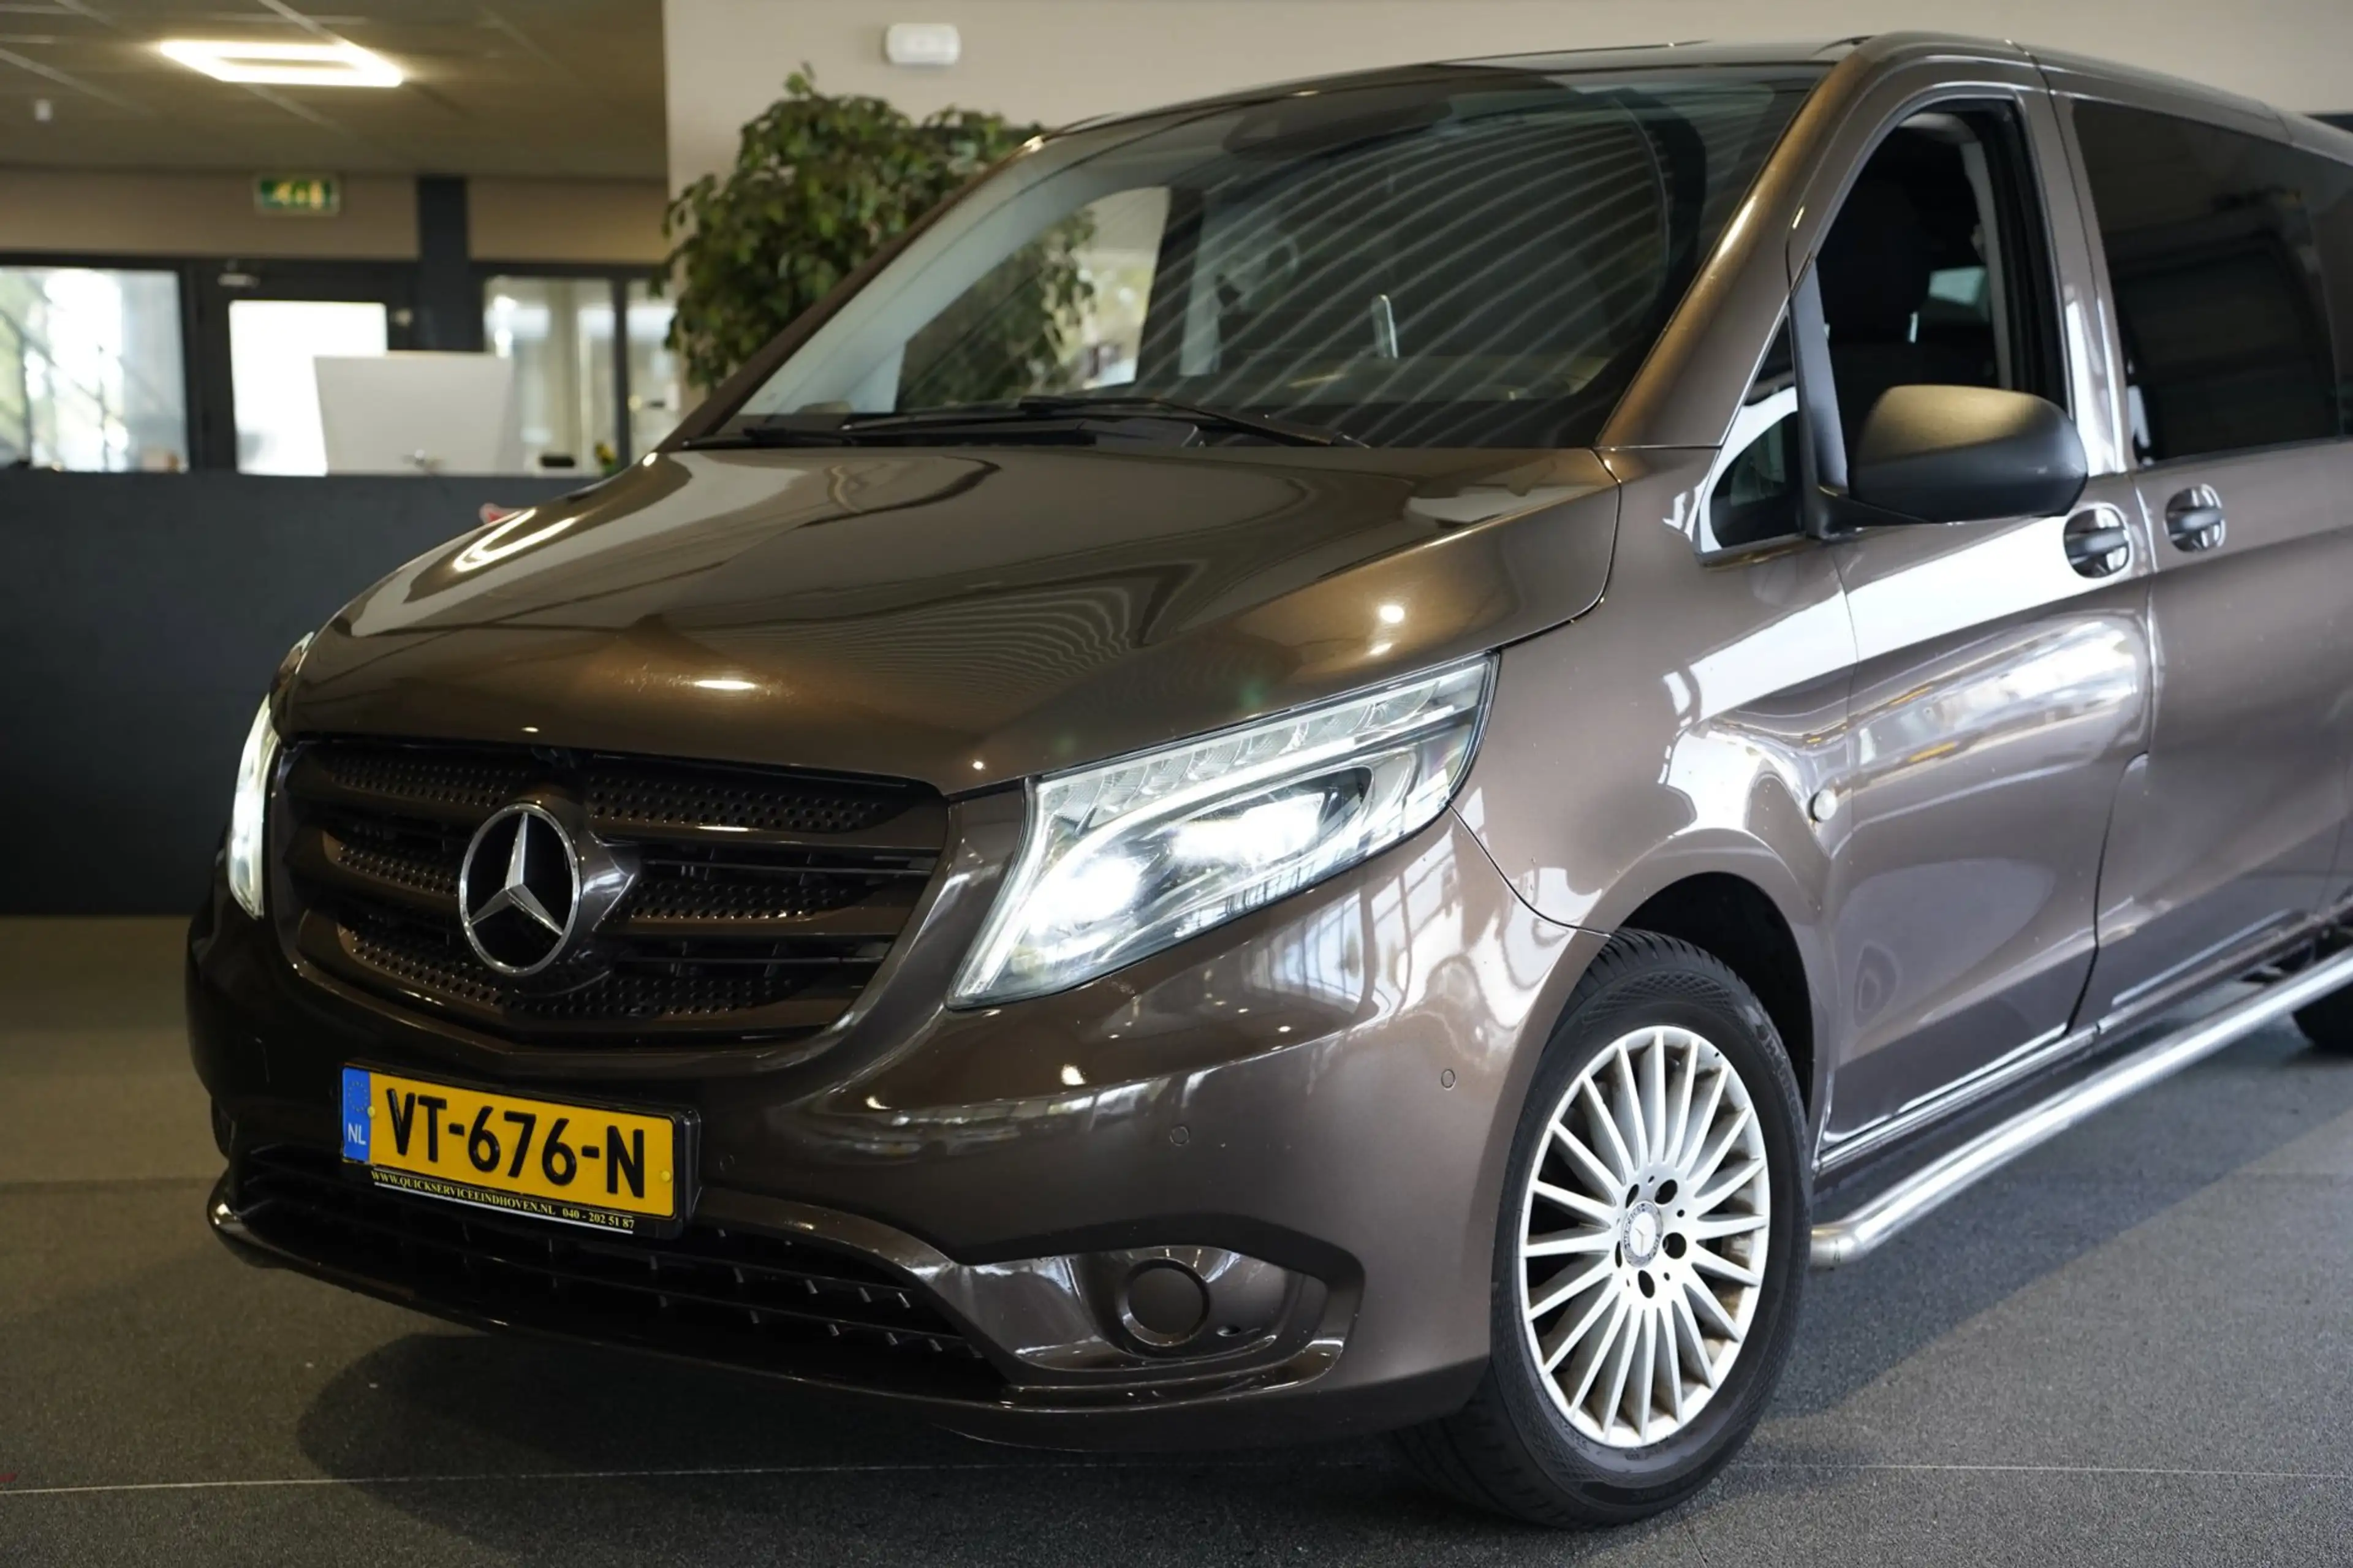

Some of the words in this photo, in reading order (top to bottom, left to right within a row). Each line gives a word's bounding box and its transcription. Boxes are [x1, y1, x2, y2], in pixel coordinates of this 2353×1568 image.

[347, 1123, 366, 1145] NL
[387, 1088, 645, 1198] VT-676-N
[370, 1170, 556, 1215] WWW.QUICKSERVICEEINDHOVEN.NL
[562, 1207, 580, 1219] 040
[588, 1211, 606, 1224] 202
[608, 1217, 620, 1227] 51
[622, 1218, 635, 1229] 87
